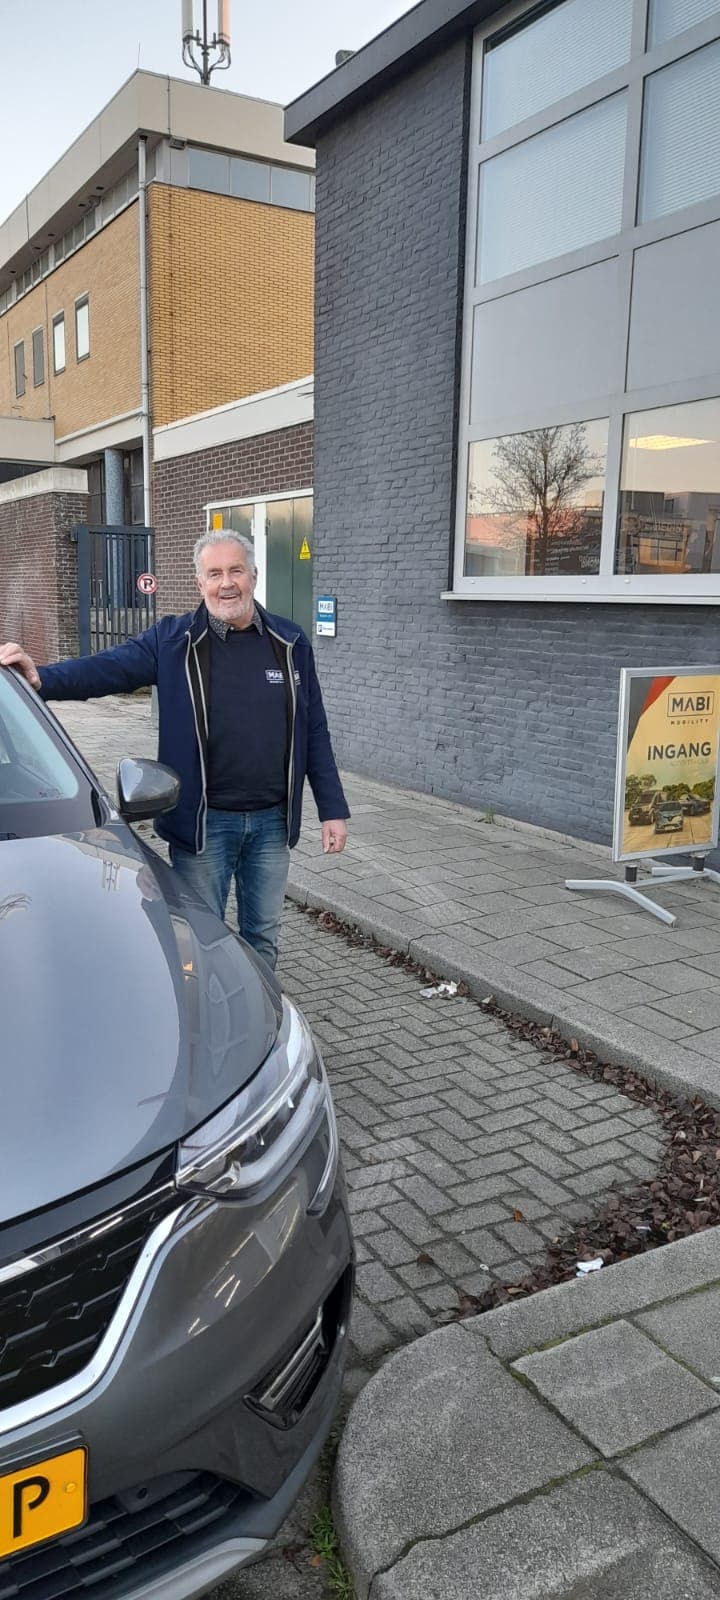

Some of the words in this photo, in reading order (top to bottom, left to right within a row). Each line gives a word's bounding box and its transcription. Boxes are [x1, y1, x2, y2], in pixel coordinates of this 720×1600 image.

[671, 696, 710, 712] MABI
[648, 742, 711, 760] INGANG
[13, 1475, 50, 1538] P
